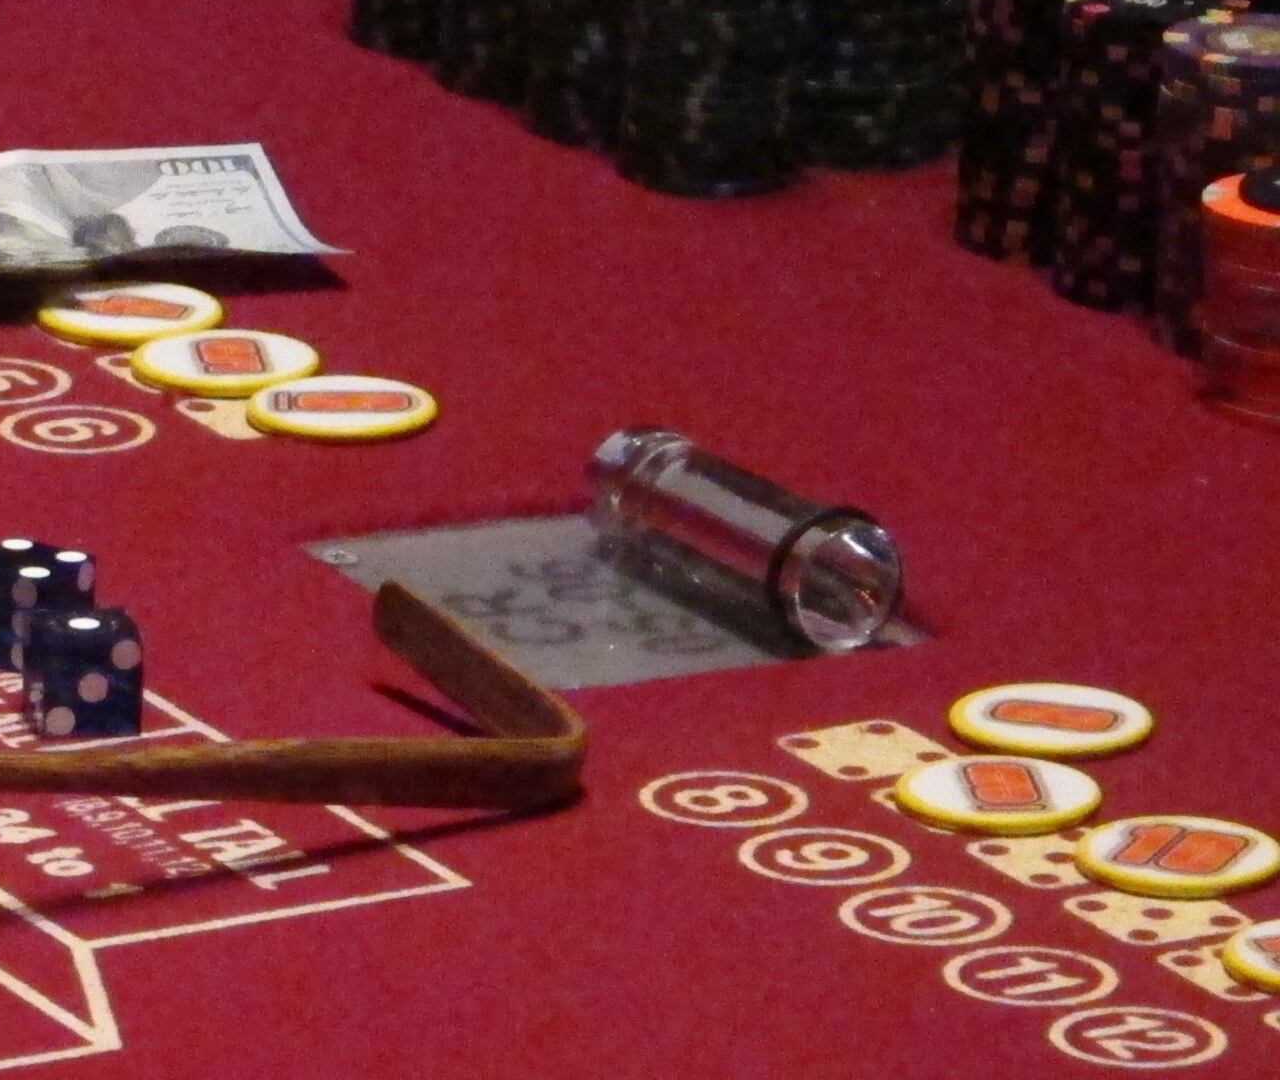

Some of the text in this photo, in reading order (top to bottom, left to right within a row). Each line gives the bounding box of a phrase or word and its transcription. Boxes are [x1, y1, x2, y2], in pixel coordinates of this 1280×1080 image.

[32, 417, 119, 442] 6
[673, 784, 770, 815] 8
[24, 846, 95, 879] to
[179, 818, 333, 891] TALL
[775, 839, 871, 871] 9
[867, 893, 981, 937] 10
[976, 955, 1085, 997] 11
[1088, 1015, 1196, 1060] 12
